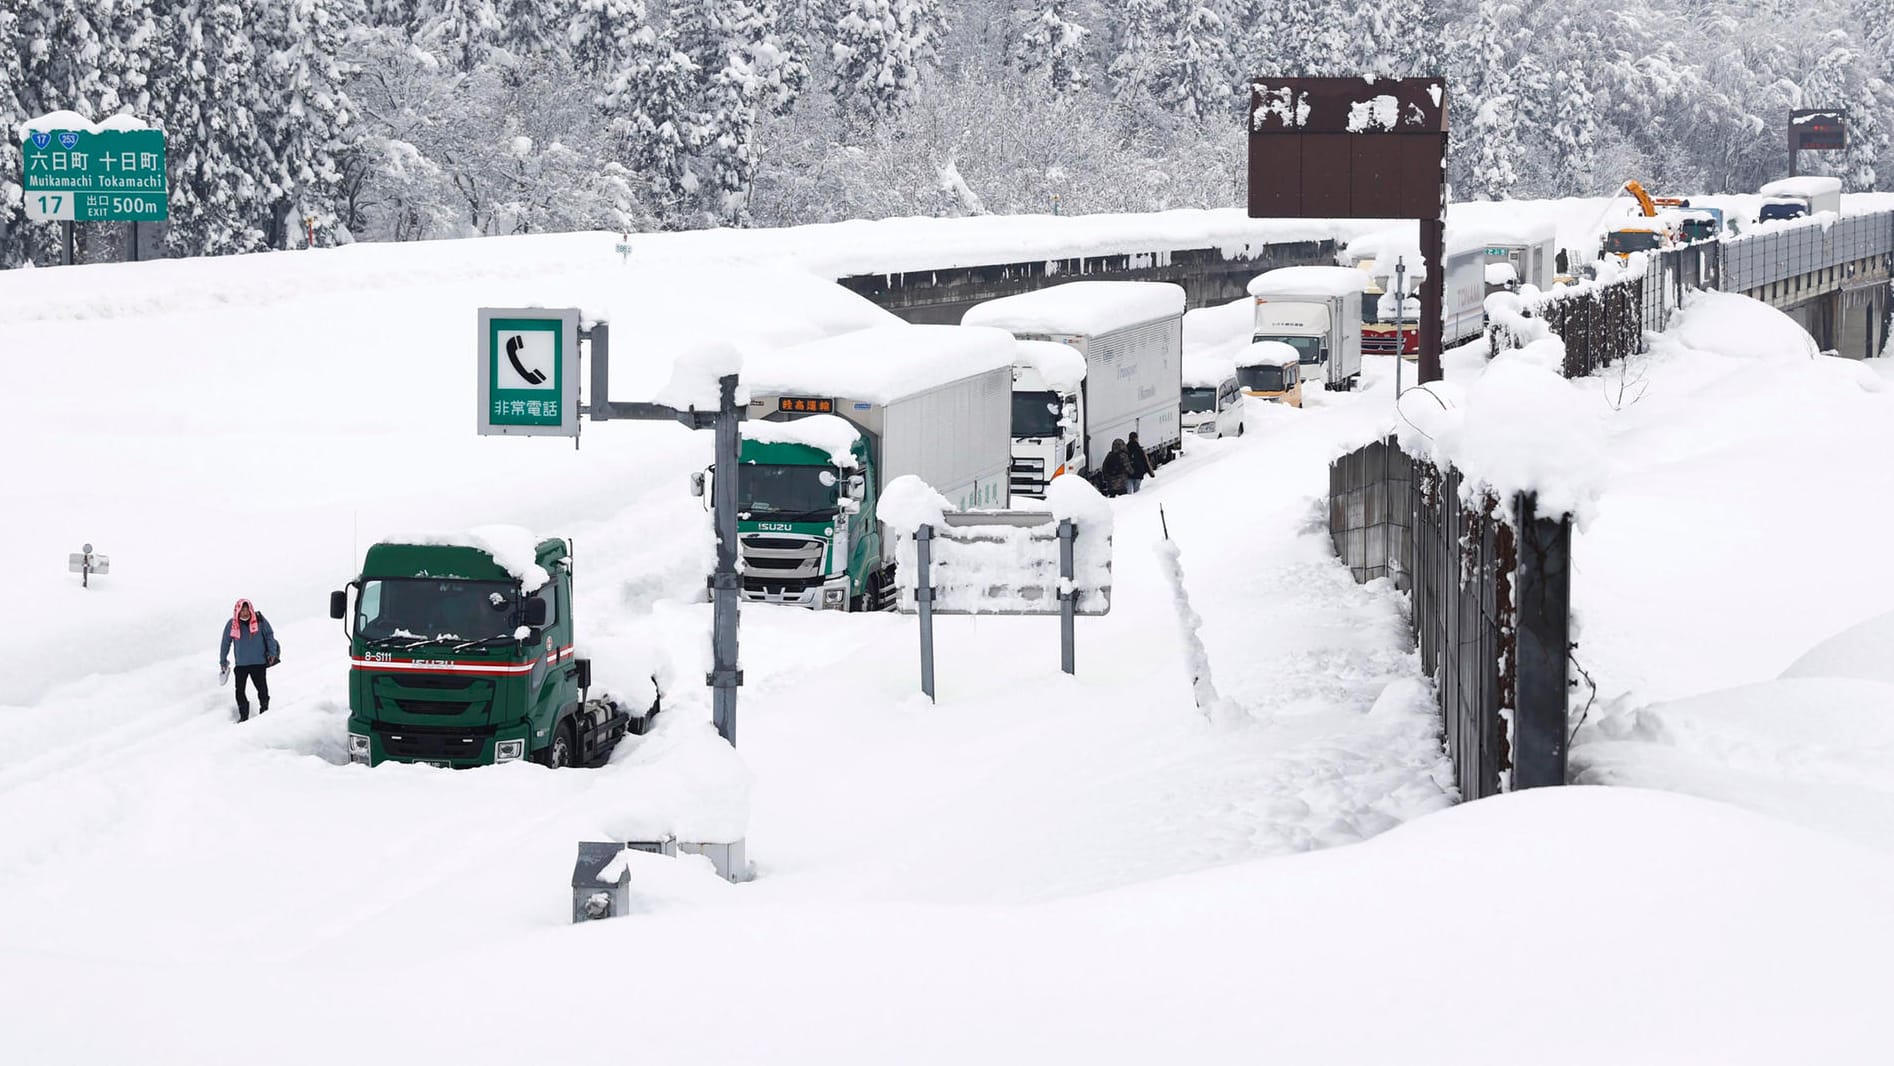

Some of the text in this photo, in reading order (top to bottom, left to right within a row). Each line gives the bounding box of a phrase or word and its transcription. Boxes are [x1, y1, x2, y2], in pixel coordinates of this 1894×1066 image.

[36, 135, 47, 145] 17
[62, 135, 76, 144] 253
[30, 151, 158, 171] 六日町 十日町
[29, 174, 161, 188] Muikamachi Tokamachi
[38, 195, 62, 214] 17
[87, 195, 109, 206] 出口
[113, 198, 157, 213] 500m
[88, 208, 108, 216] EXIT
[495, 400, 557, 416] 非常電話
[758, 523, 792, 531] ISUZU
